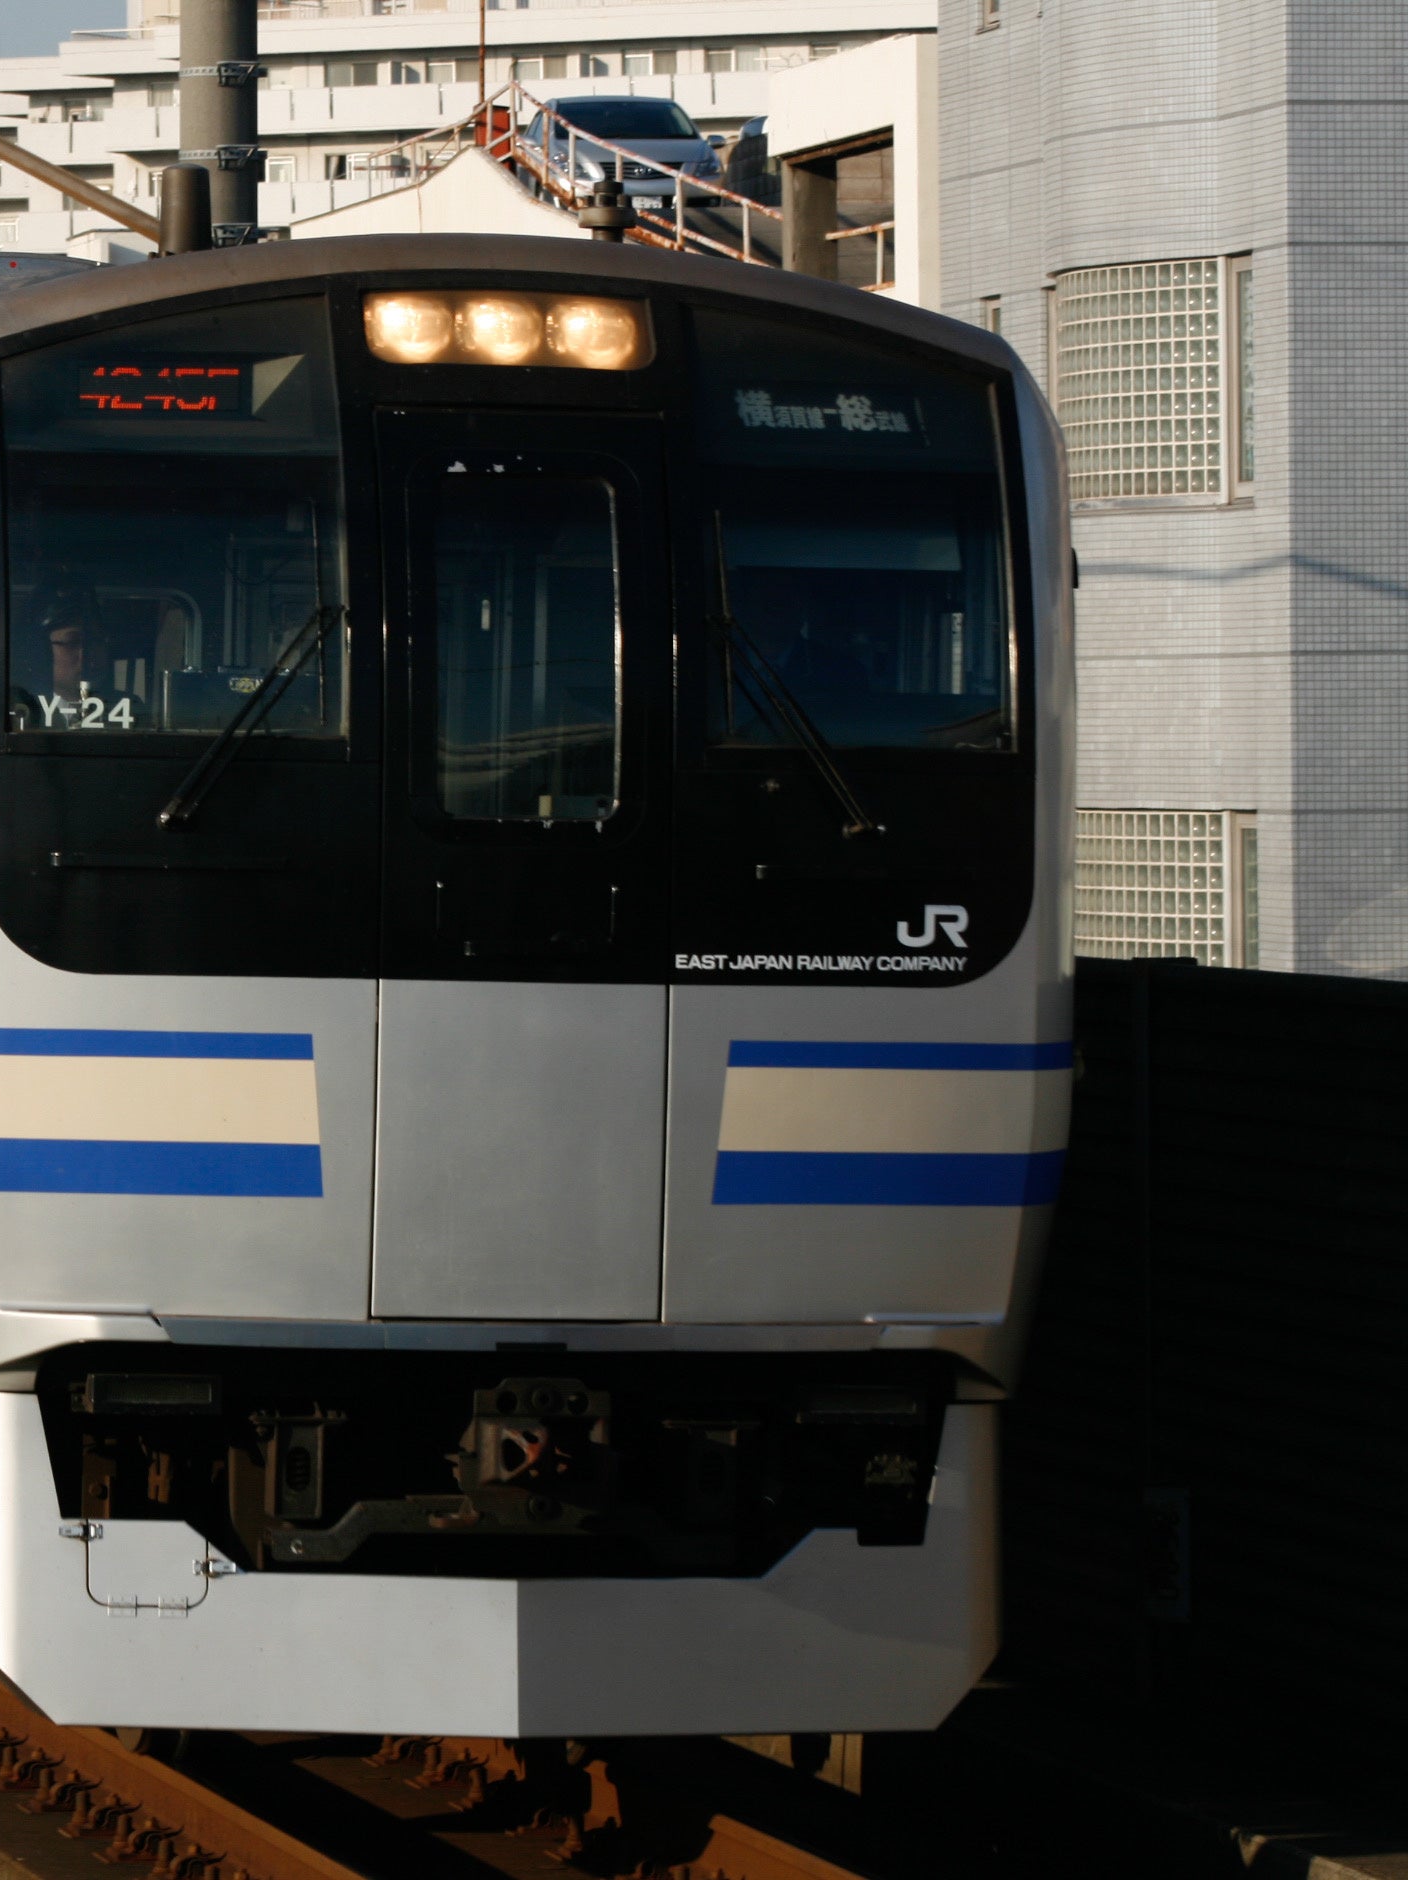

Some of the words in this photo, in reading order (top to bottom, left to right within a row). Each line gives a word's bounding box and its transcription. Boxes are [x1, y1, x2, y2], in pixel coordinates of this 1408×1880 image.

[37, 694, 135, 729] Y-24
[896, 904, 969, 948] JR
[674, 953, 728, 970] EAST
[729, 954, 793, 971] JAPAN
[796, 955, 874, 971] RAILWAY
[876, 956, 968, 972] COMPANY
